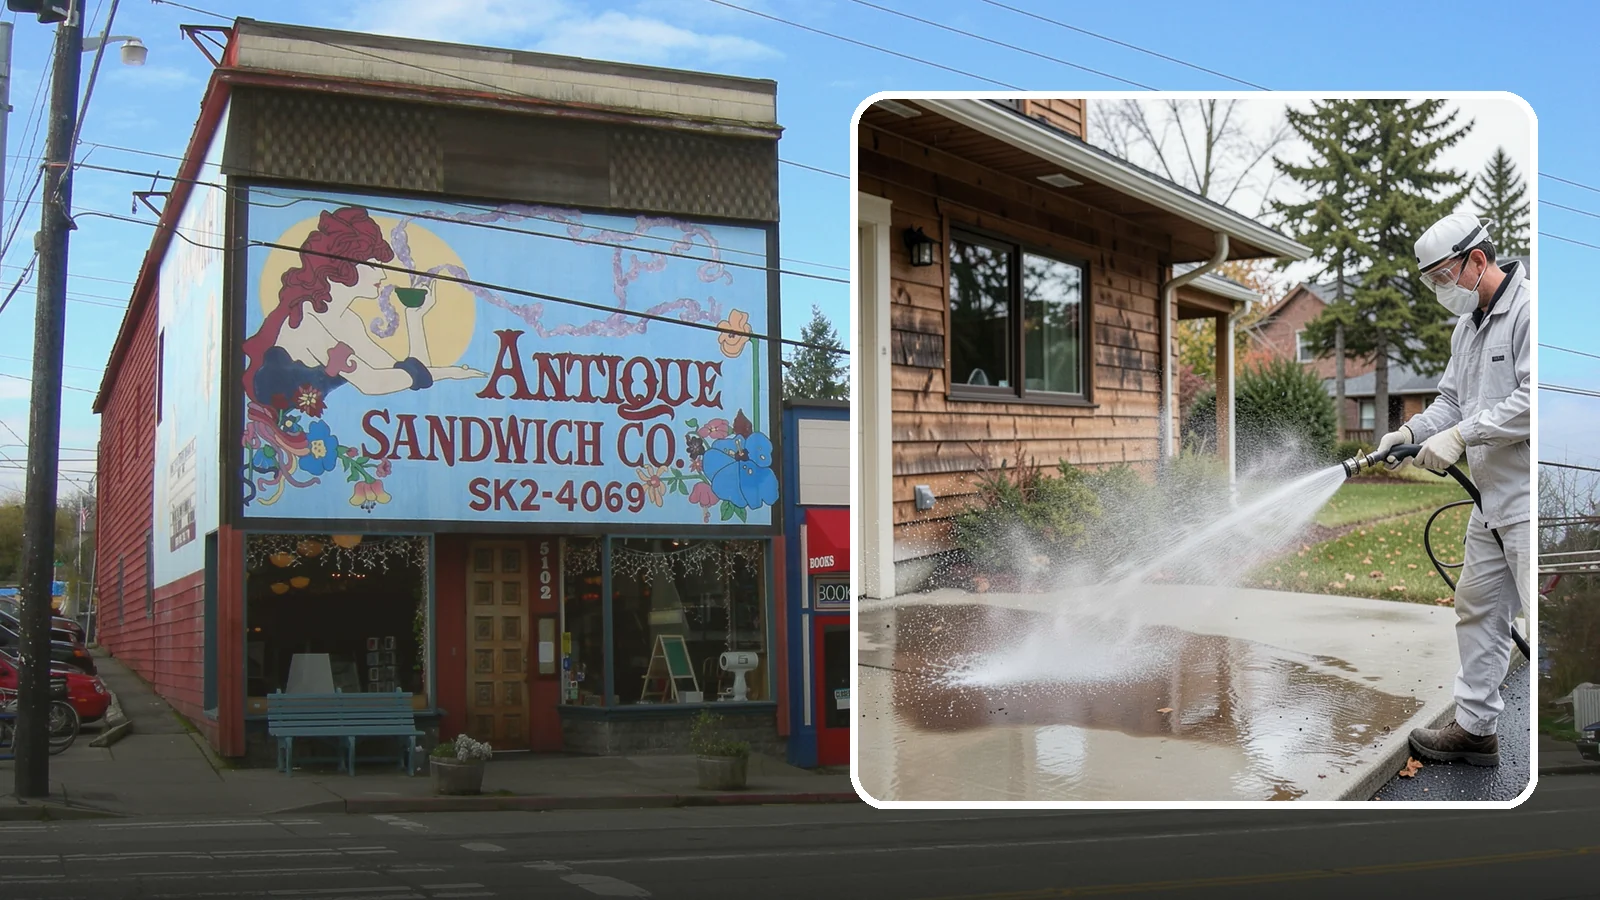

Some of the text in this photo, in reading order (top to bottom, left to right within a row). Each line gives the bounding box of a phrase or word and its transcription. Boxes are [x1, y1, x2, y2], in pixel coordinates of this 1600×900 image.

[476, 329, 723, 420] ANTIQUE
[361, 408, 685, 468] SANDWICH CO.
[468, 476, 646, 513] SK2-4069
[539, 541, 552, 599] 5102
[809, 555, 835, 569] BOOKS
